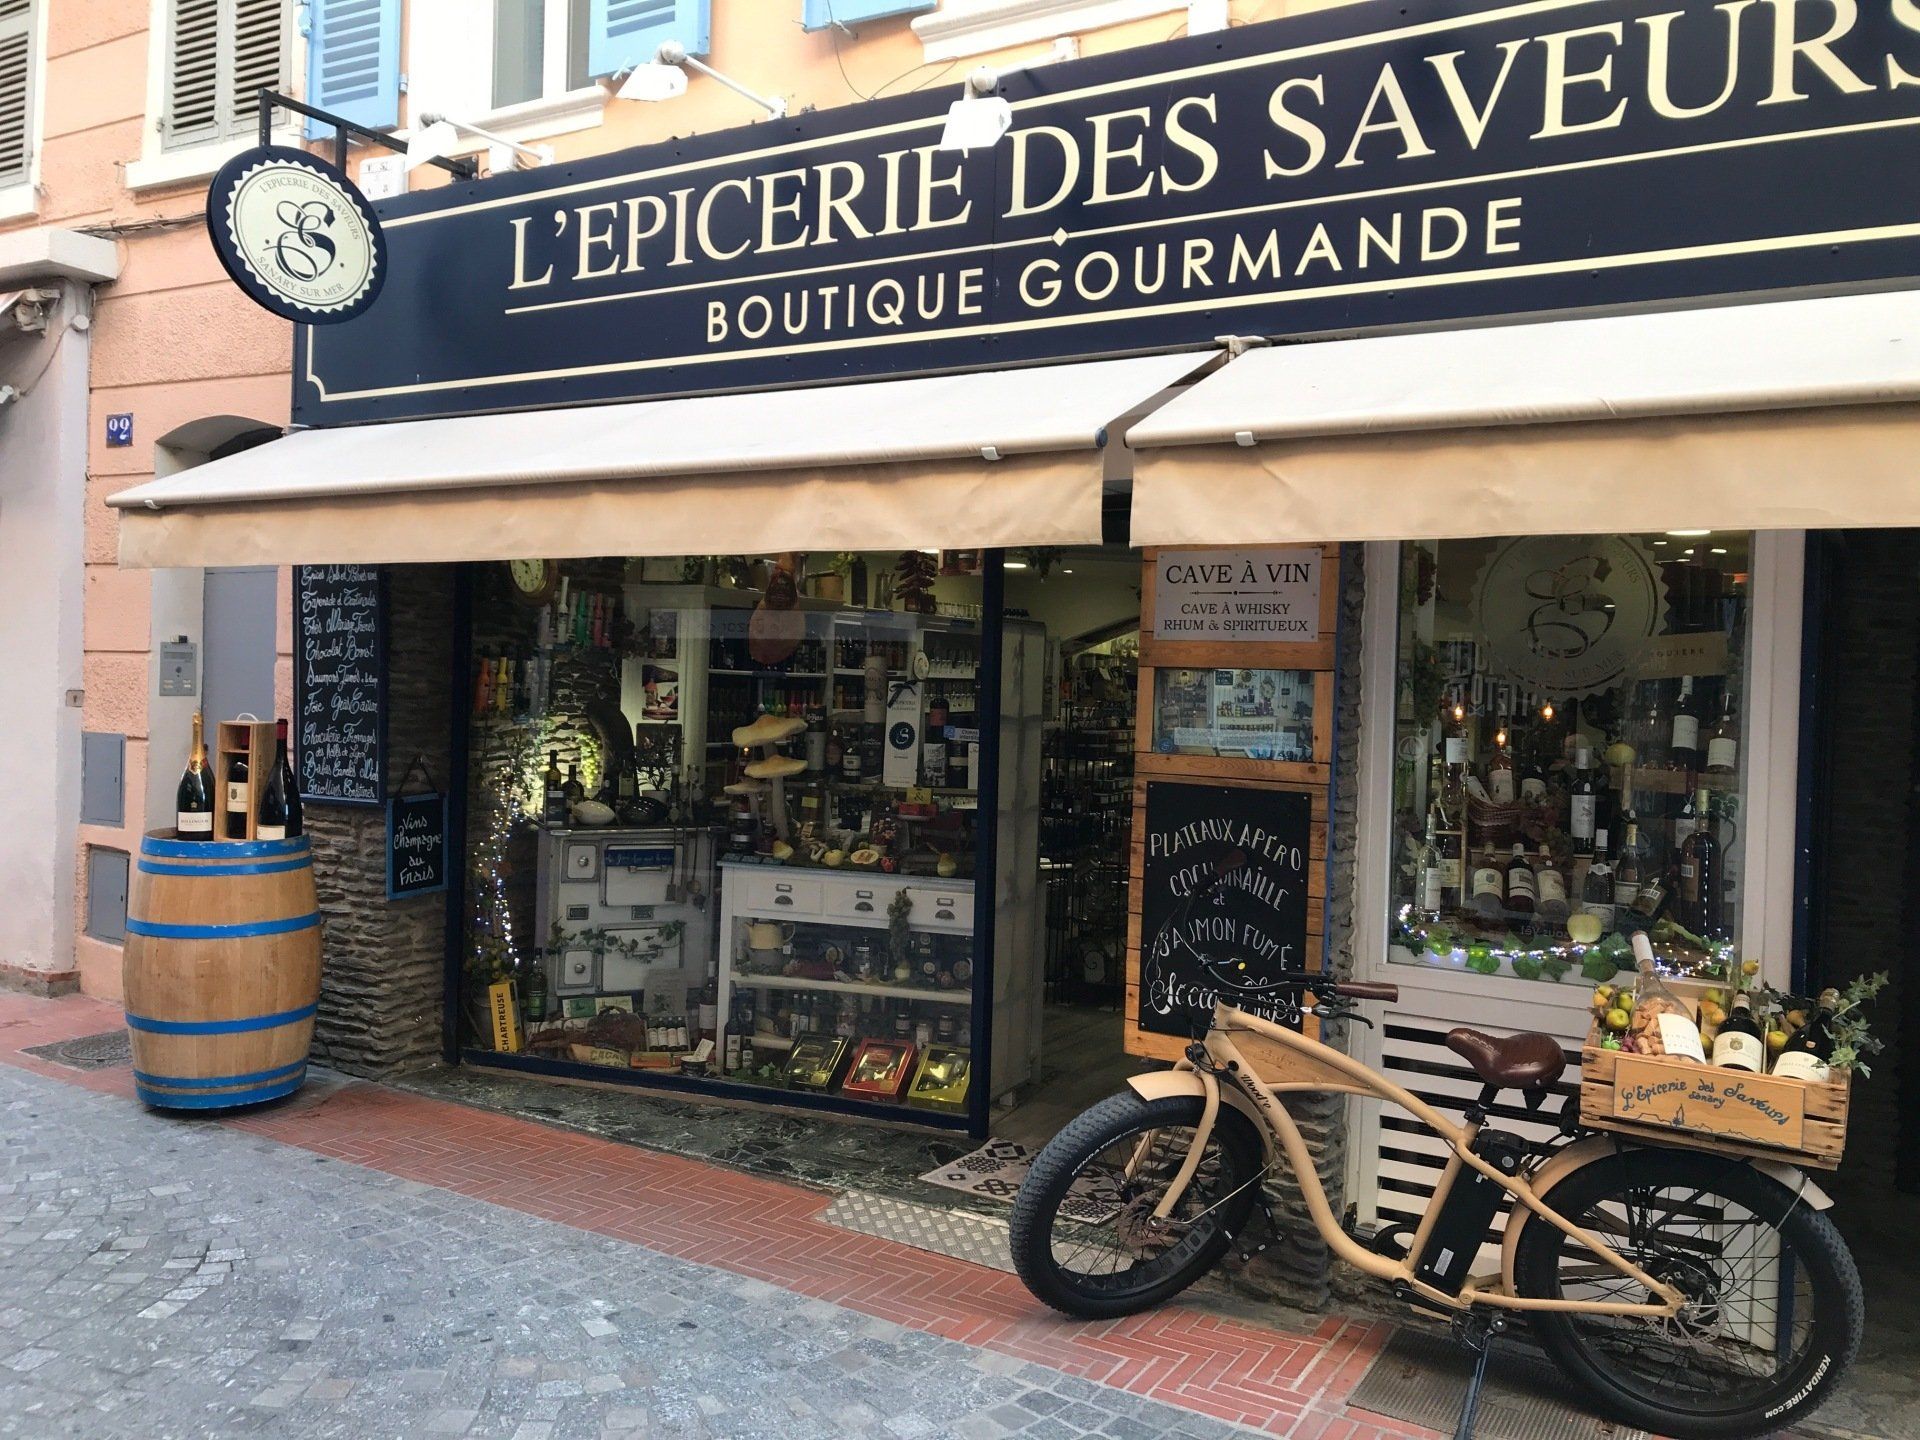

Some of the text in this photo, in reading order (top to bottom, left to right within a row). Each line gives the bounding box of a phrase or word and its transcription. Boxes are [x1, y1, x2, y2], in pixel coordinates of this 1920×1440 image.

[507, 143, 973, 290] L'EPICERIE
[1001, 92, 1219, 218] DES
[259, 176, 360, 241] L'EPICERIE DES SAVEURS
[257, 256, 344, 297] SANARY SUR MER
[706, 197, 1522, 343] BOUTIQUE GOURMANDE
[1166, 560, 1311, 584] CAVE À VIN
[1181, 601, 1291, 614] CAVE À WHISKY
[1164, 619, 1308, 632] RHUM & SPIRITUEUX
[402, 812, 427, 830] Vins
[1150, 818, 1235, 857] PLATEAUX
[393, 825, 442, 853] Champagne
[399, 865, 434, 886] Frais
[408, 855, 425, 867] au
[1213, 892, 1225, 905] et
[500, 992, 510, 1052] CHARTREUSE
[1697, 1078, 1715, 1092] des
[1723, 1083, 1791, 1126] Saveurs
[1764, 1353, 1832, 1419] KENDATIRE.COM
